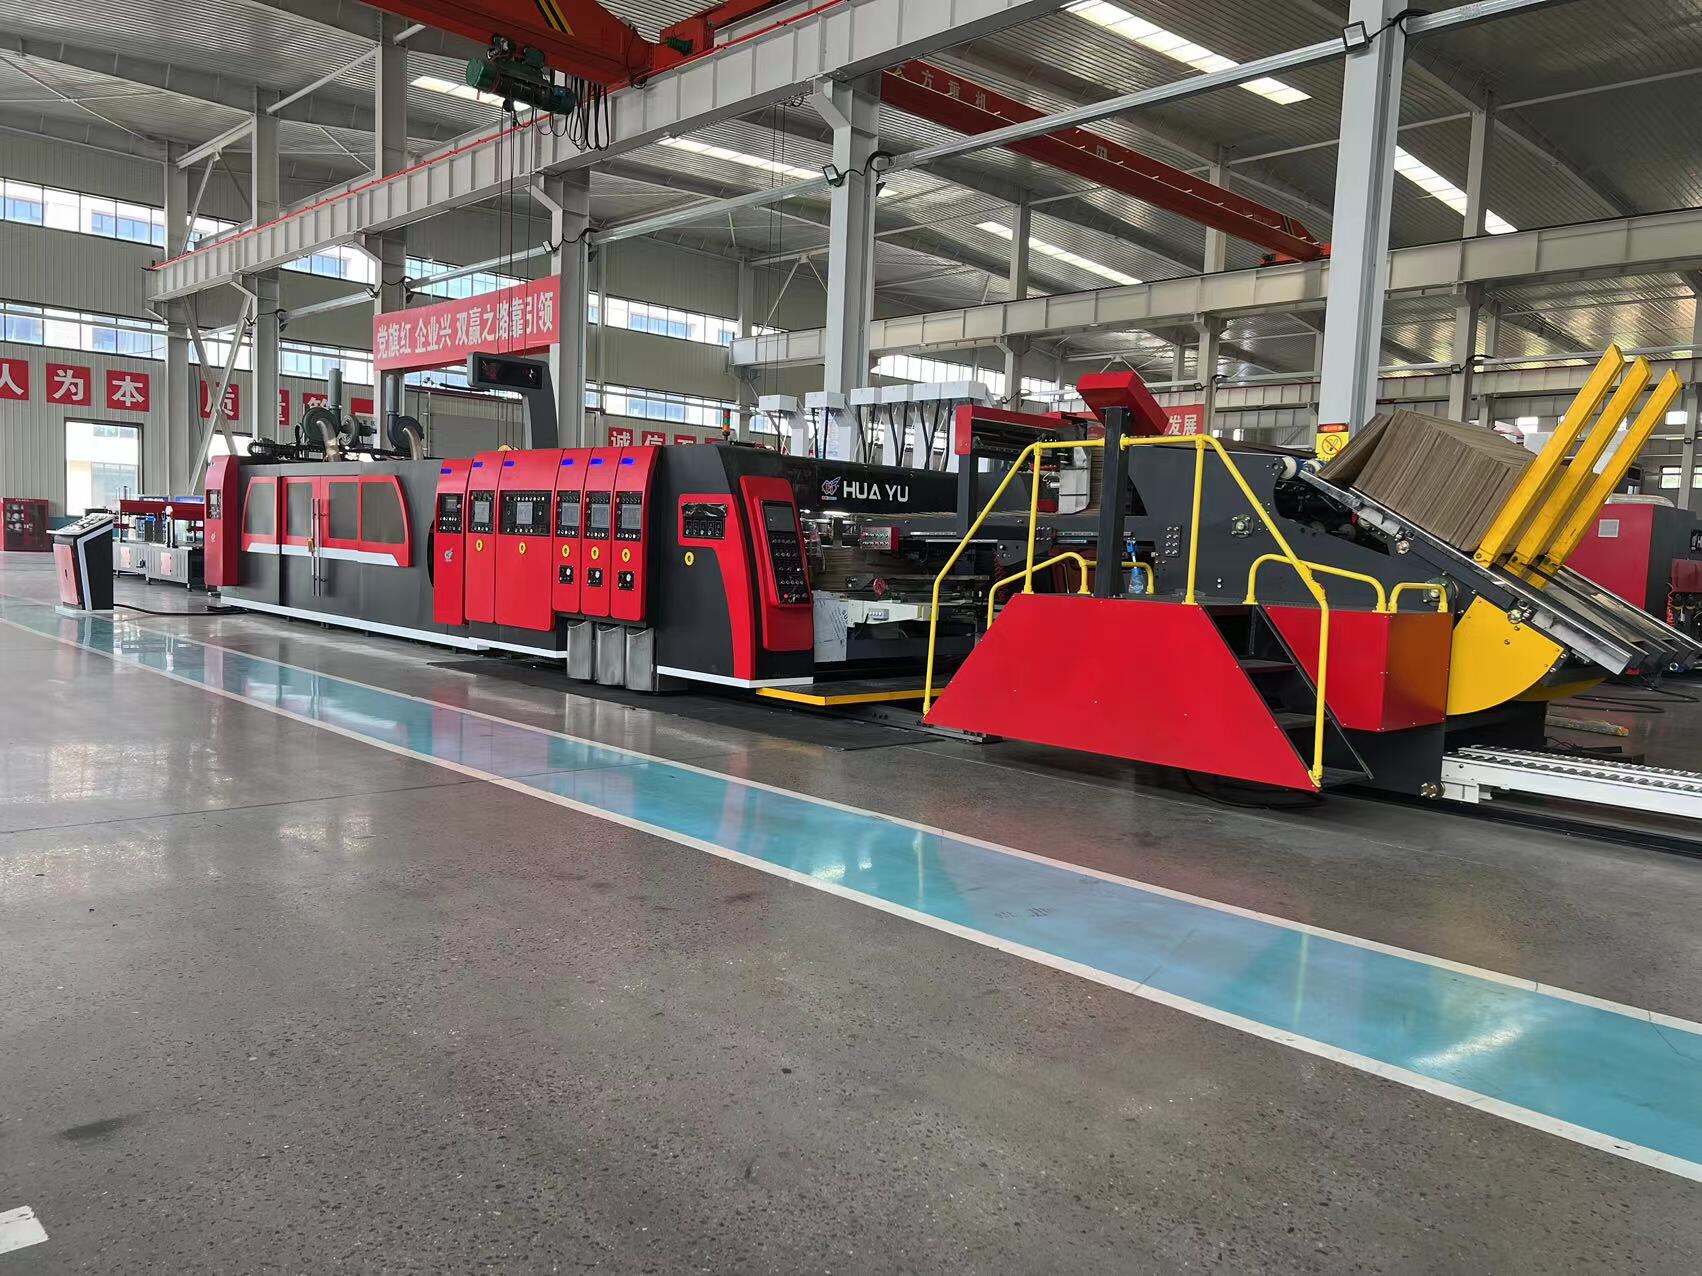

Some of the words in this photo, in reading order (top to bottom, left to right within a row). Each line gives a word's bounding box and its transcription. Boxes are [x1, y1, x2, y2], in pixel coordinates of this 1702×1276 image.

[377, 322, 411, 359] 党旗红
[415, 314, 451, 353] 企业兴
[843, 481, 881, 500] HUA
[885, 484, 909, 502] YU
